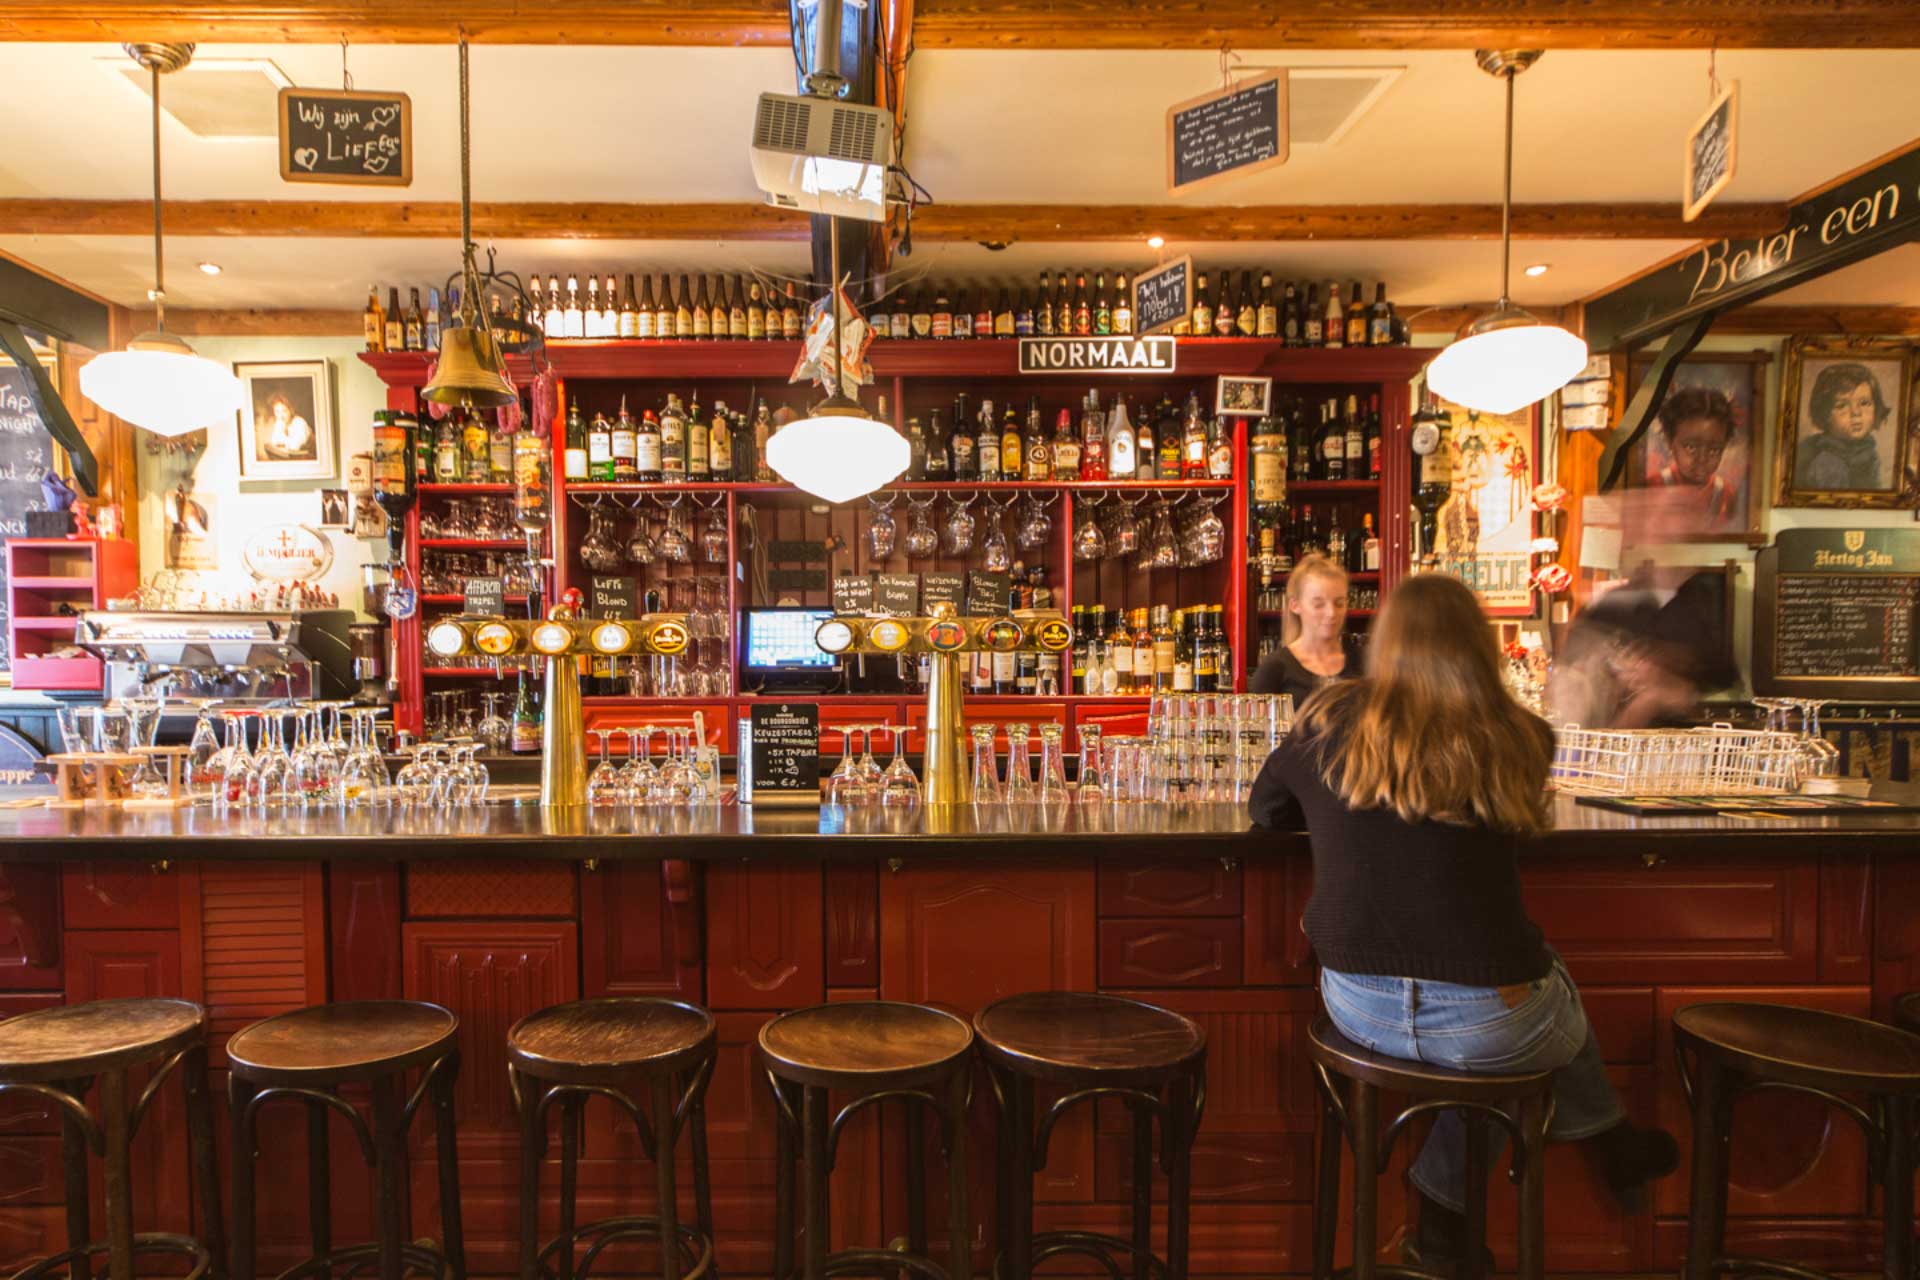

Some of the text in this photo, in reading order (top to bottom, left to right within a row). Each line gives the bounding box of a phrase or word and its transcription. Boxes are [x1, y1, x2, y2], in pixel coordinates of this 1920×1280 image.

[298, 101, 325, 131] Wij
[1821, 183, 1900, 245] een
[1029, 342, 1167, 368] NORMAAL
[0, 384, 31, 413] TAP
[1814, 549, 1894, 568] Hertog Jan
